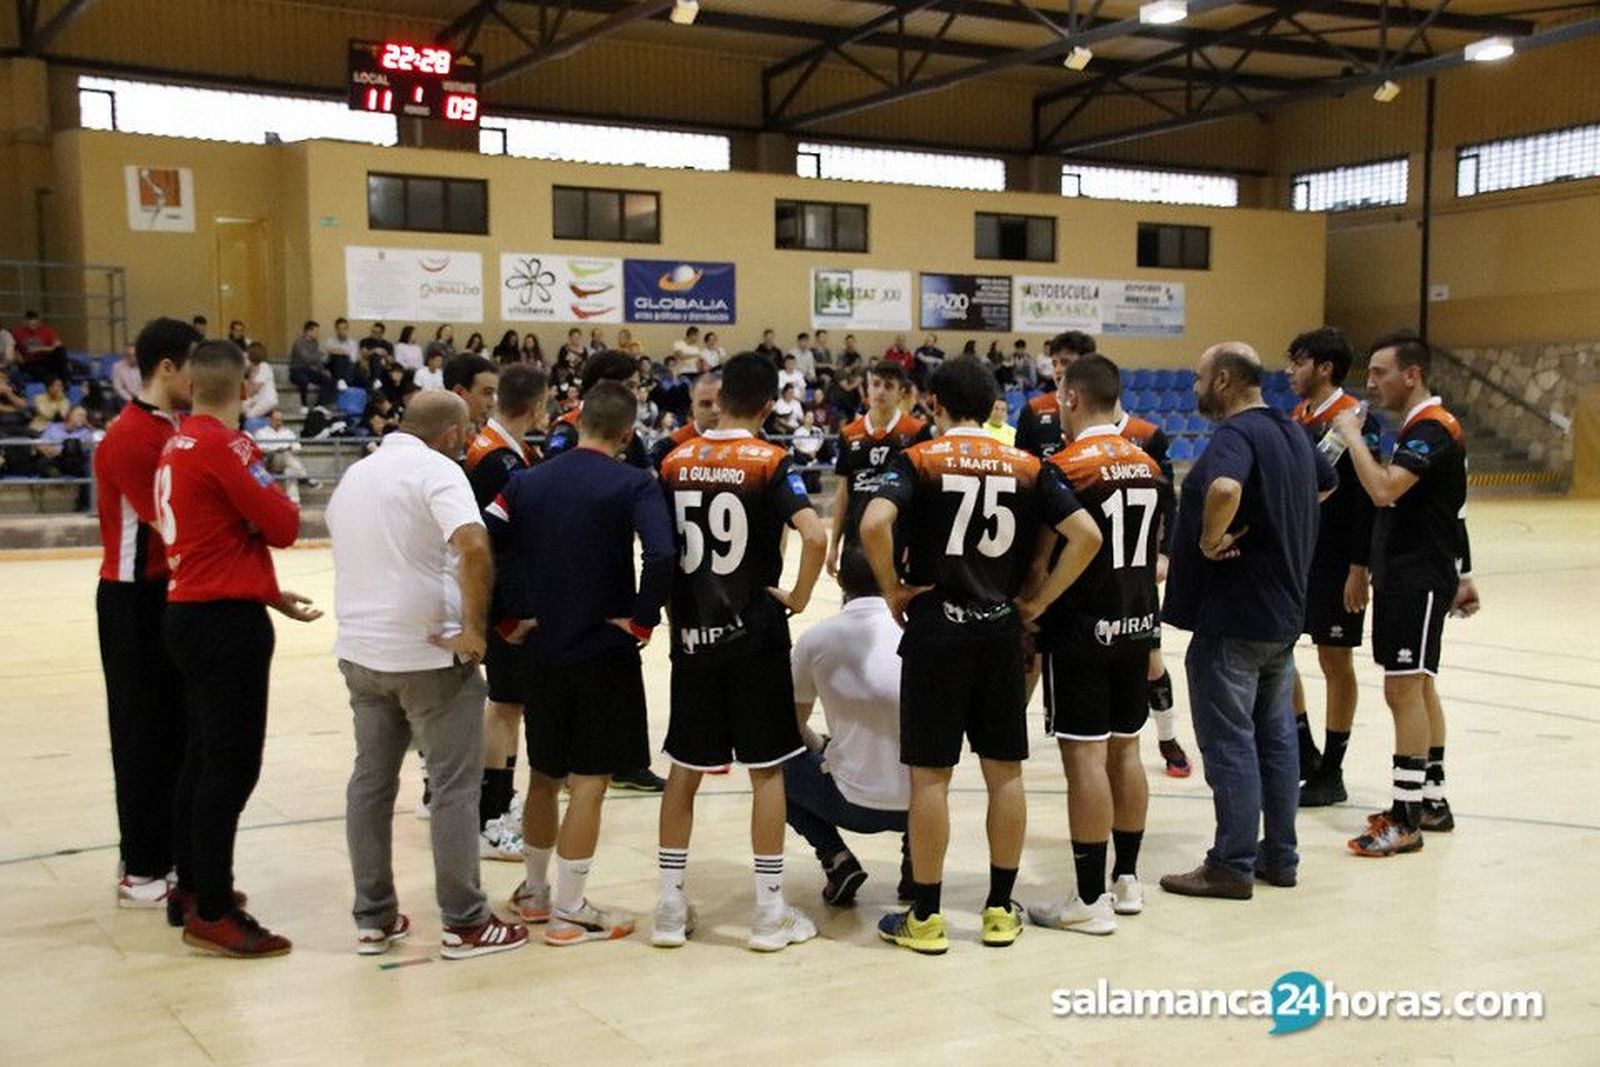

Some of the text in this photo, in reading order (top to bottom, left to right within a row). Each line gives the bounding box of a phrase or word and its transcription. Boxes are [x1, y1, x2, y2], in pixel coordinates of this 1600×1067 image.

[382, 44, 451, 74] 22:28
[368, 88, 392, 111] 11
[446, 96, 477, 121] 09
[635, 297, 729, 310] GLOBALIA
[869, 446, 891, 466] 67
[690, 466, 745, 485] GUIJARRO
[941, 474, 1017, 558] 75
[673, 490, 749, 575] 59
[1101, 488, 1158, 570] 17
